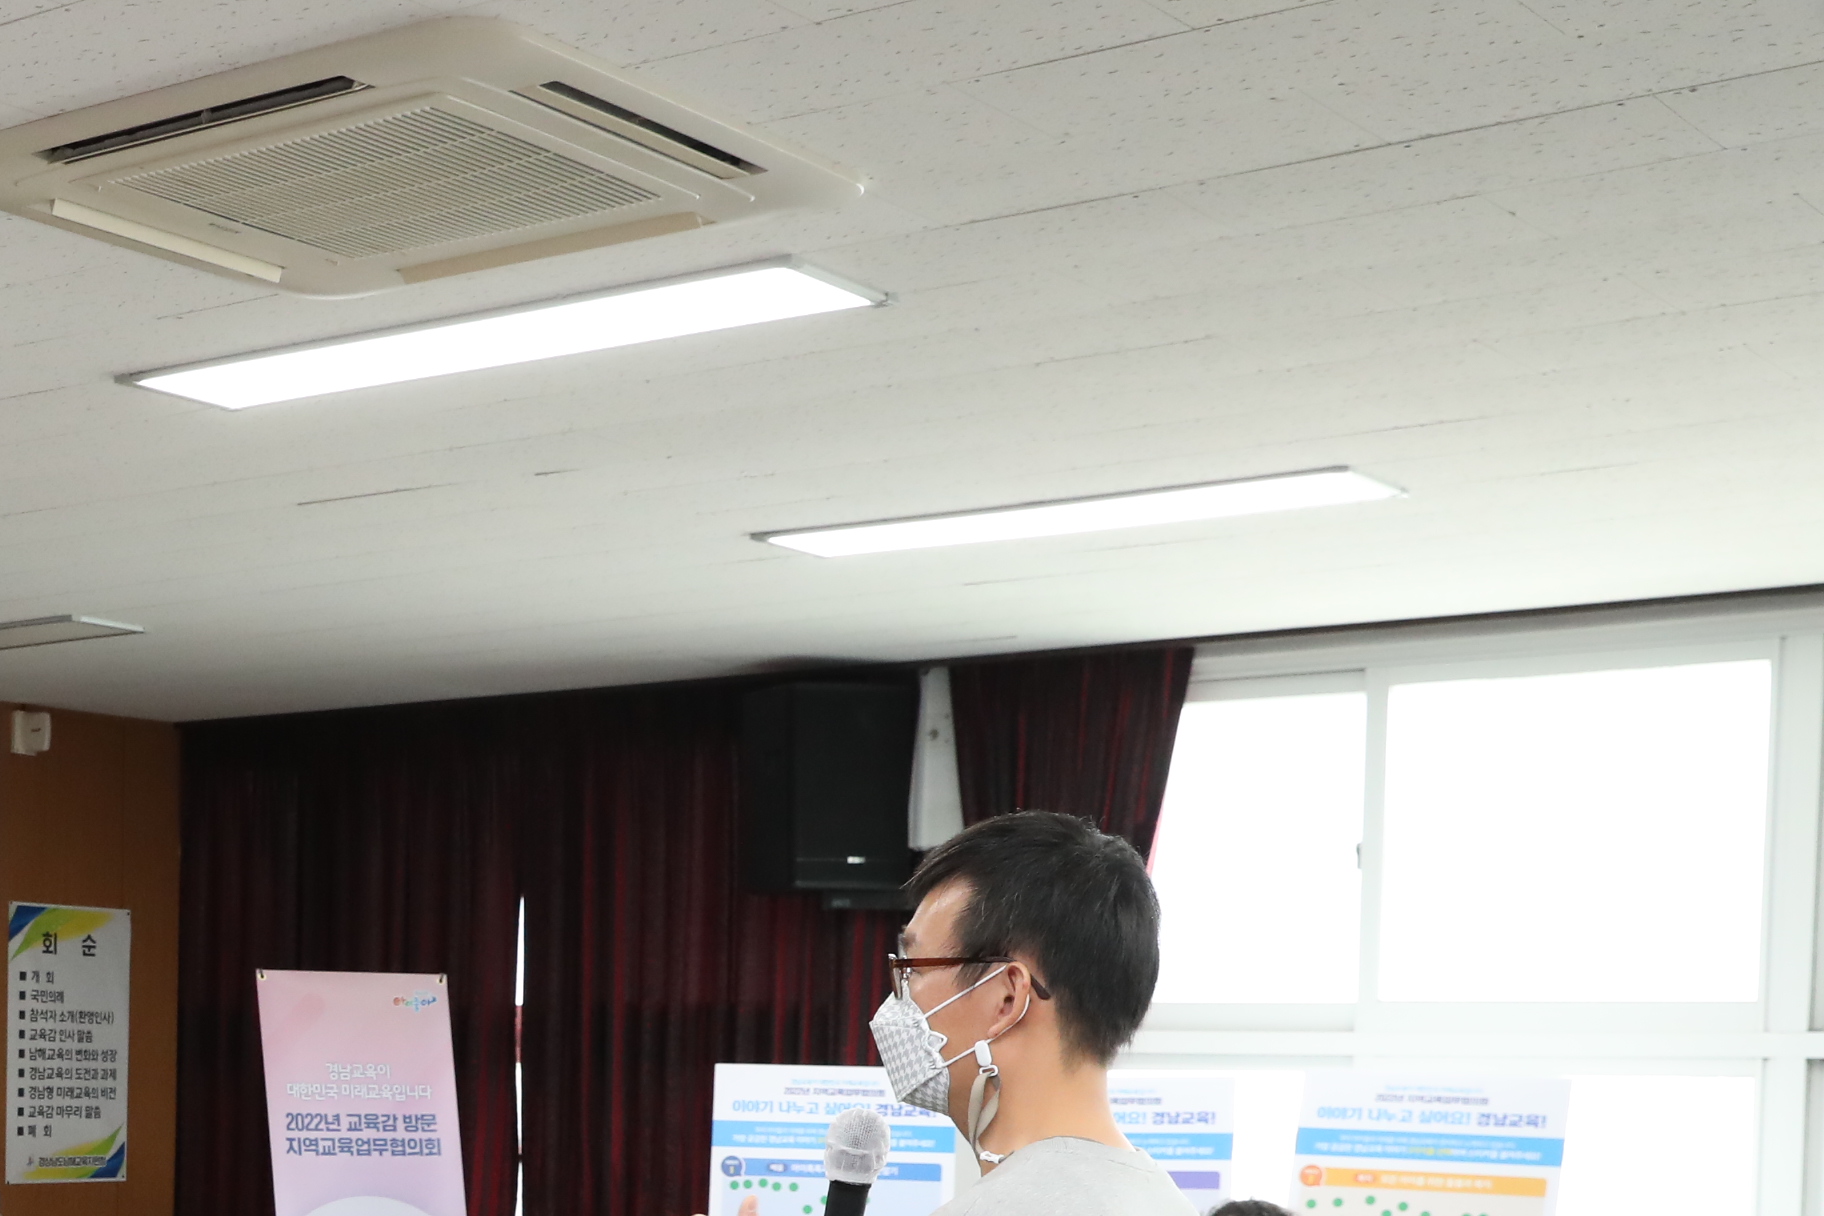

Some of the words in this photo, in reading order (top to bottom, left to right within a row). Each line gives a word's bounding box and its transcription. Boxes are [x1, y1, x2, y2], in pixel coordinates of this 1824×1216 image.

[30, 989, 65, 1004] 국민의례
[29, 1008, 57, 1022] 참석자
[29, 1028, 57, 1042] 교육감
[58, 1029, 76, 1042] 인사
[76, 1030, 93, 1043] 말씀
[28, 1048, 73, 1061] 남해교육의
[100, 1049, 117, 1062] 성장
[28, 1067, 73, 1080] 경남교육의
[75, 1068, 99, 1081] 도전과
[100, 1068, 117, 1081] 과제
[326, 1062, 391, 1080] 경남교육이
[28, 1086, 54, 1100] 경남형
[56, 1087, 99, 1100] 미래교육의
[100, 1087, 117, 1100] 비전
[287, 1083, 339, 1101] 대한민국
[341, 1083, 432, 1101] 미래교육입니다
[27, 1105, 54, 1119] 교육감
[56, 1106, 83, 1119] 마무리
[85, 1106, 102, 1119] 말씀
[732, 1100, 774, 1114] 이야기
[778, 1101, 821, 1115] 나누고
[285, 1112, 342, 1132] 2022년
[346, 1113, 398, 1133] 교육감
[402, 1113, 438, 1133] 방문
[1151, 1111, 1217, 1125] 경남교육!
[285, 1136, 442, 1157] 지역교육업무협의회
